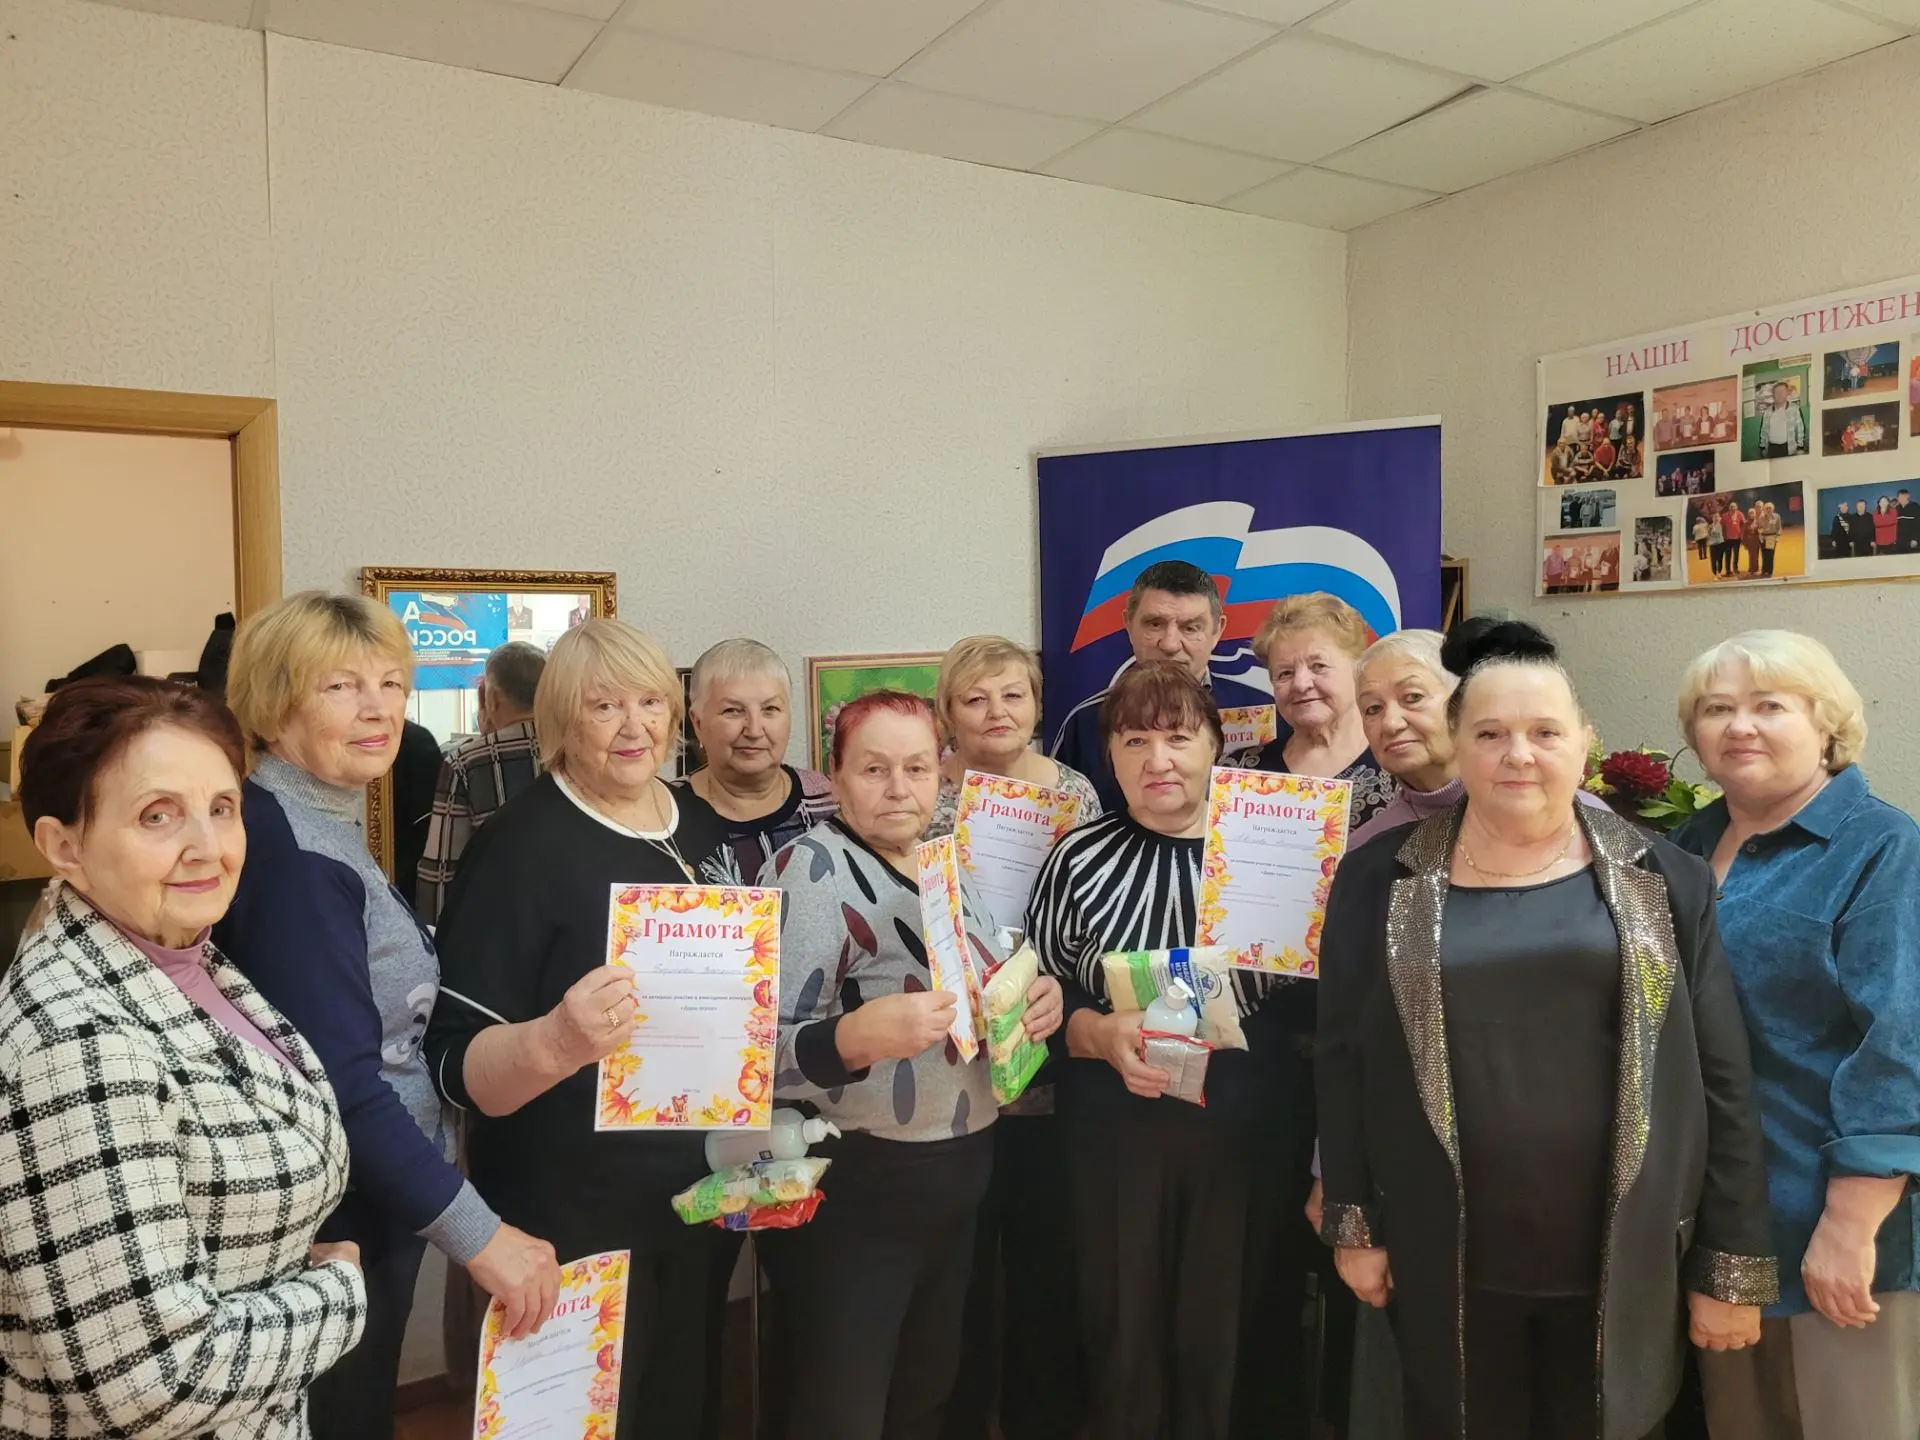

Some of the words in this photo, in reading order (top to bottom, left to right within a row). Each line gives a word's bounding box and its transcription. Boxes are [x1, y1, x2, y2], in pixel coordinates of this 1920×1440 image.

[1605, 339, 1690, 378] НАШИ
[1729, 290, 1920, 357] ДОСТИЖЕН
[980, 798, 1052, 827] Грамота
[1232, 796, 1317, 822] Грамота
[643, 918, 745, 944] Грамота
[669, 949, 724, 960] Награждается
